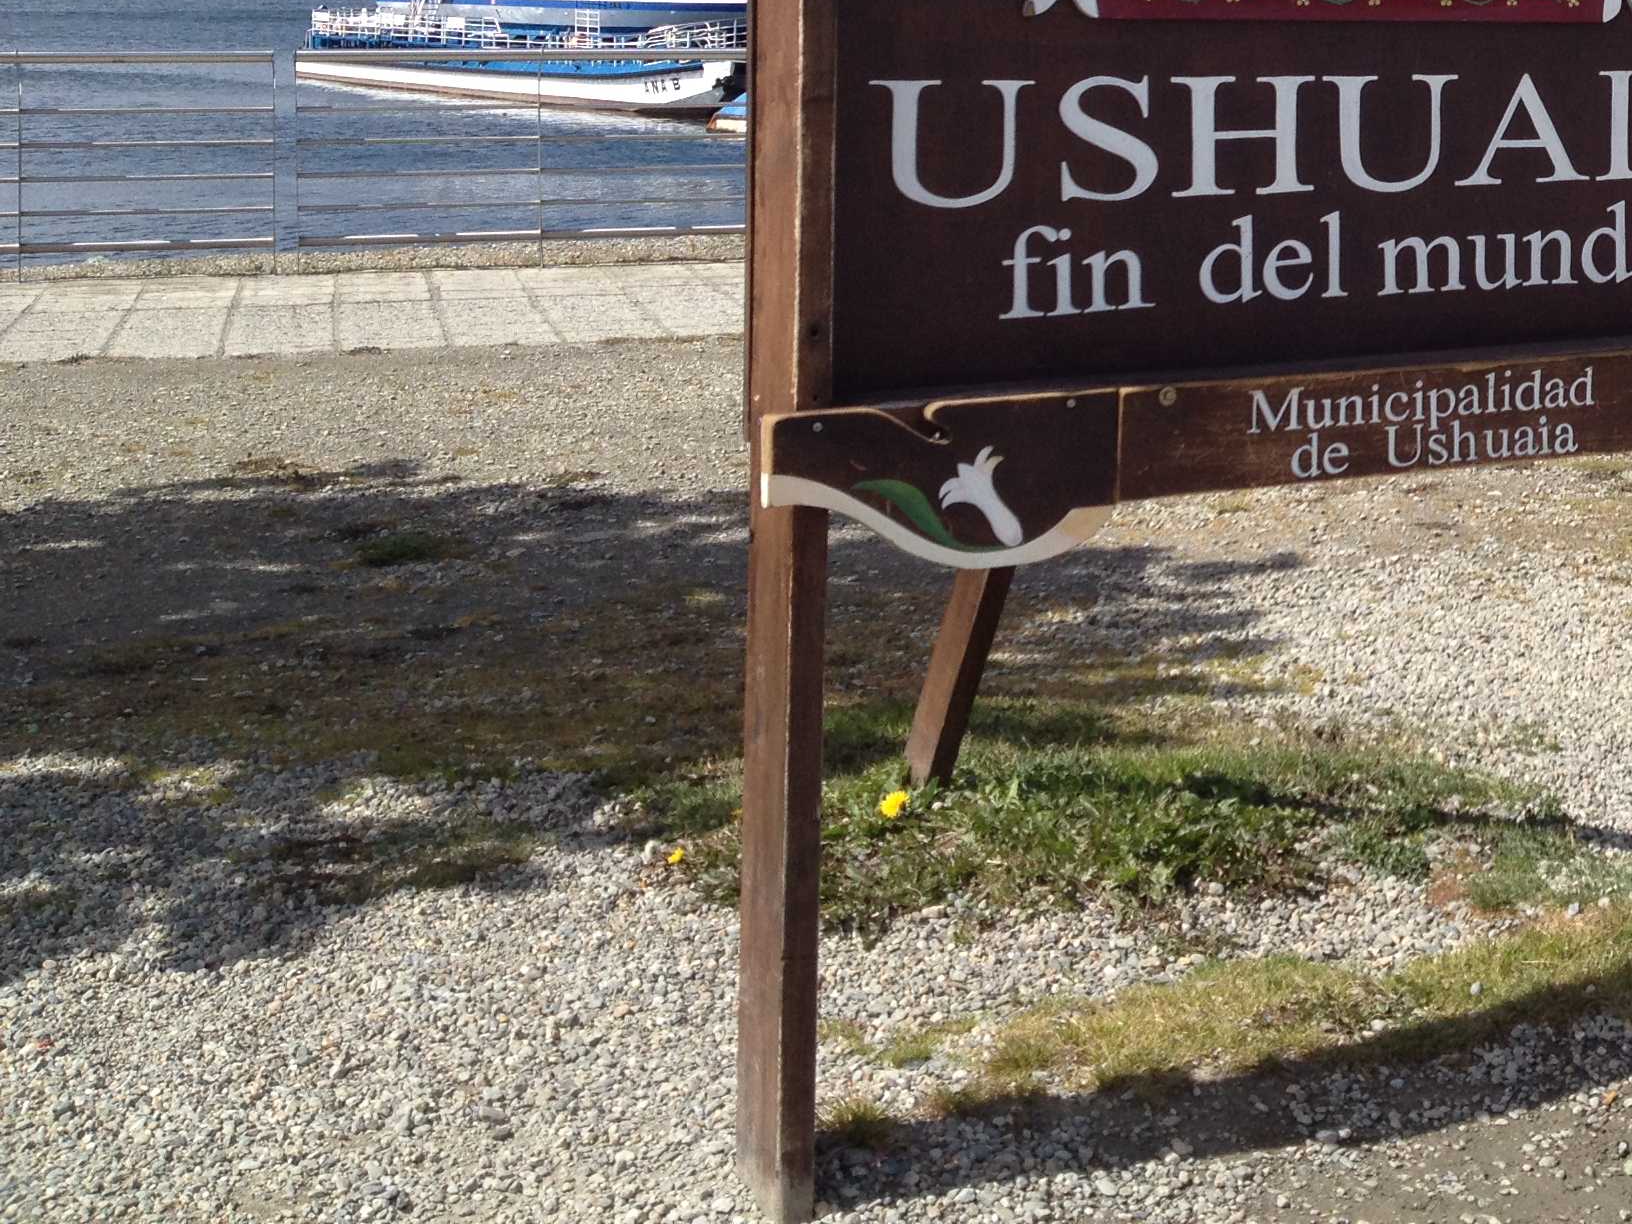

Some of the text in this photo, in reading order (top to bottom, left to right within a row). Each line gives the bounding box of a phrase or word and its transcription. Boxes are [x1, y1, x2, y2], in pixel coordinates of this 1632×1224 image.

[644, 79, 668, 95] ANA
[999, 225, 1157, 319] fin
[1199, 210, 1348, 304] del
[1247, 366, 1596, 434] Municipalidad
[1291, 419, 1579, 479] de Ushuaia
